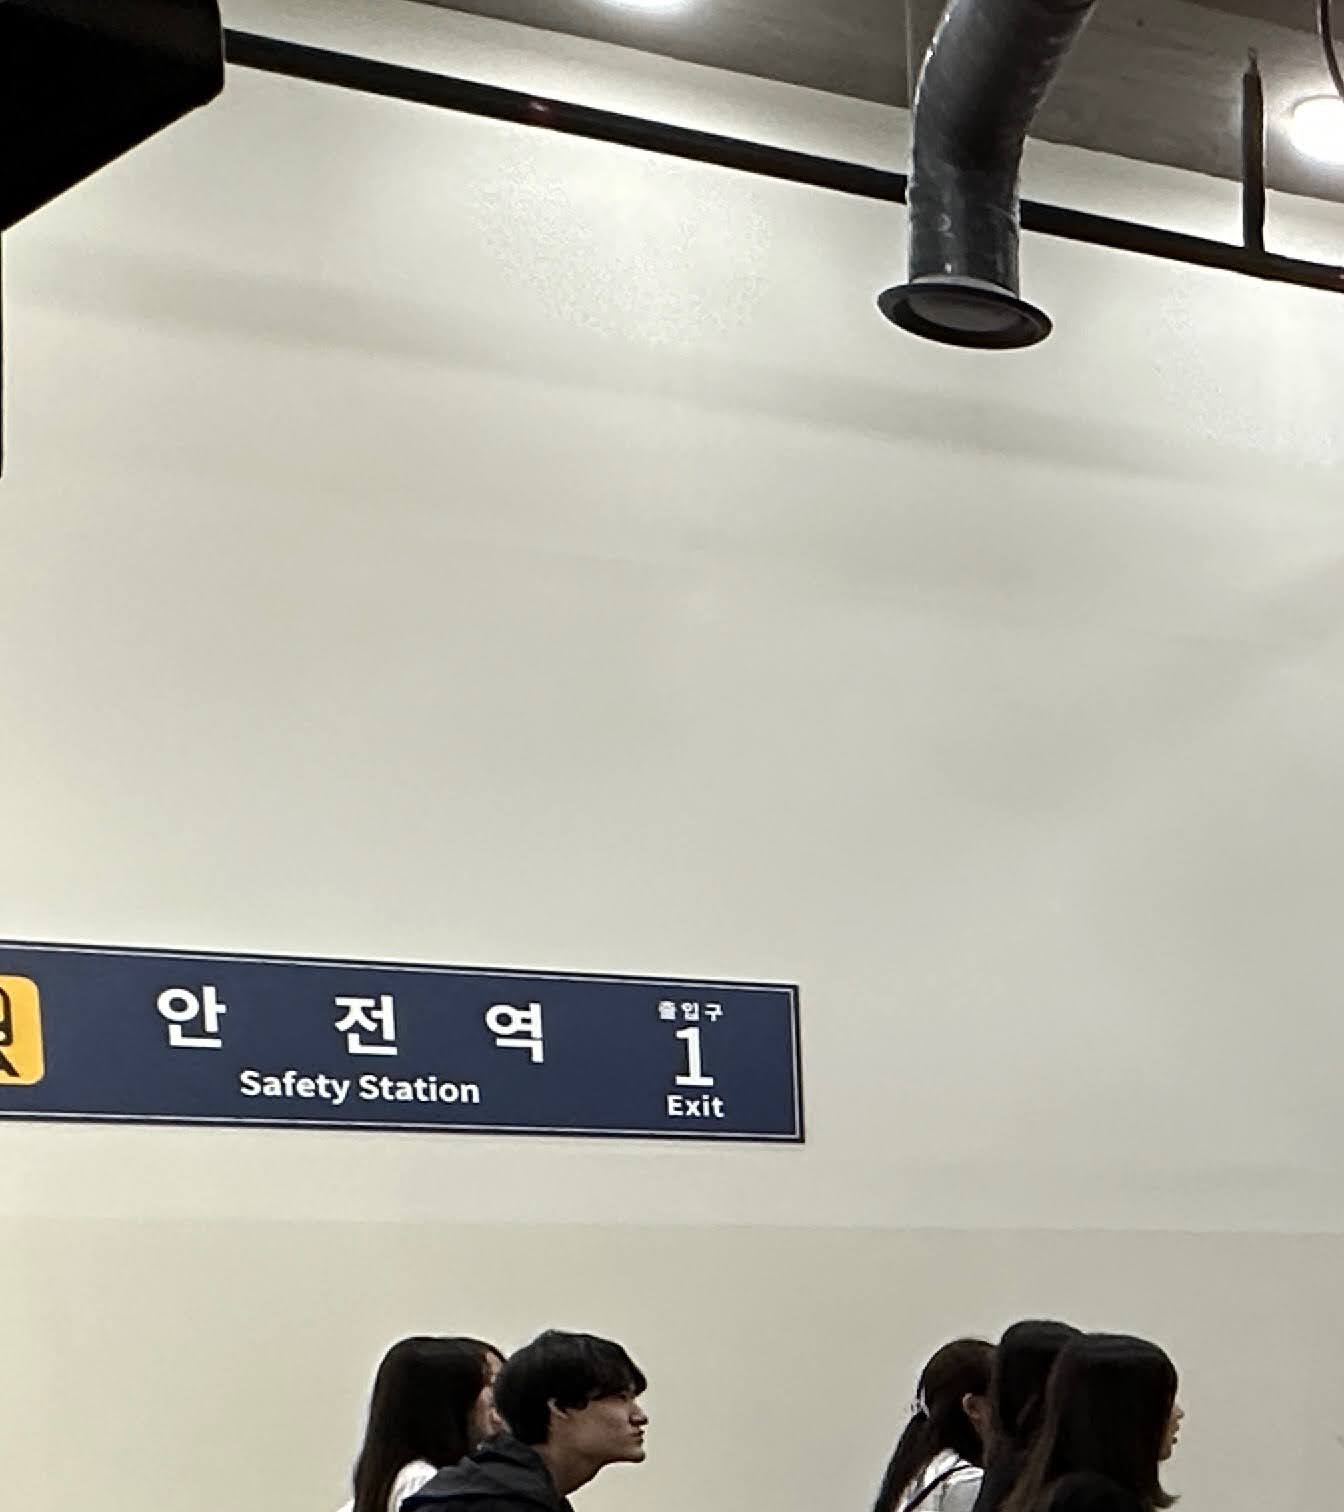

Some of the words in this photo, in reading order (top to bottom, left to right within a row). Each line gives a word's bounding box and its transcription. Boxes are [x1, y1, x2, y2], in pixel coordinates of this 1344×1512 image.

[658, 1000, 724, 1022] 출입구
[674, 1026, 714, 1087] 1
[239, 1069, 350, 1105] Safety
[358, 1075, 480, 1105] Station
[666, 1094, 725, 1118] Exit
